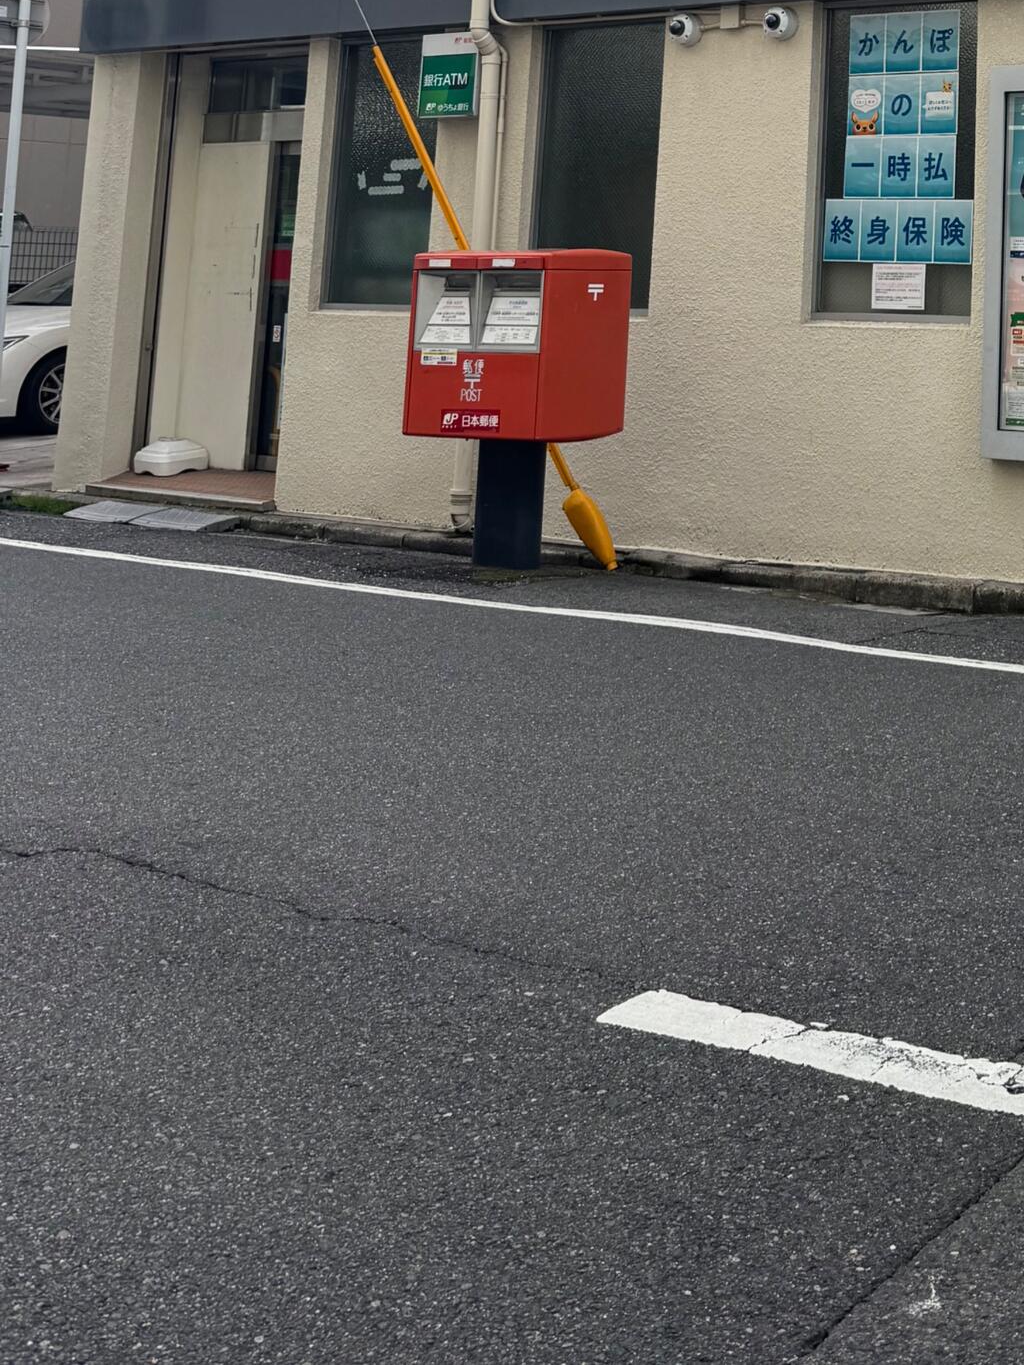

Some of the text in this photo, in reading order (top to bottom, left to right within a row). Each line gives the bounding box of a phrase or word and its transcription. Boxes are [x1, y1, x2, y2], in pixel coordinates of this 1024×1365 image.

[858, 28, 954, 57] かんぽ
[423, 72, 468, 87] 銀行ATM
[891, 94, 912, 116] の
[851, 152, 948, 182] 一時払
[830, 216, 966, 247] 終身保険
[462, 359, 484, 374] 郵便
[460, 388, 483, 402] POST
[462, 415, 499, 427] 日本郵便
